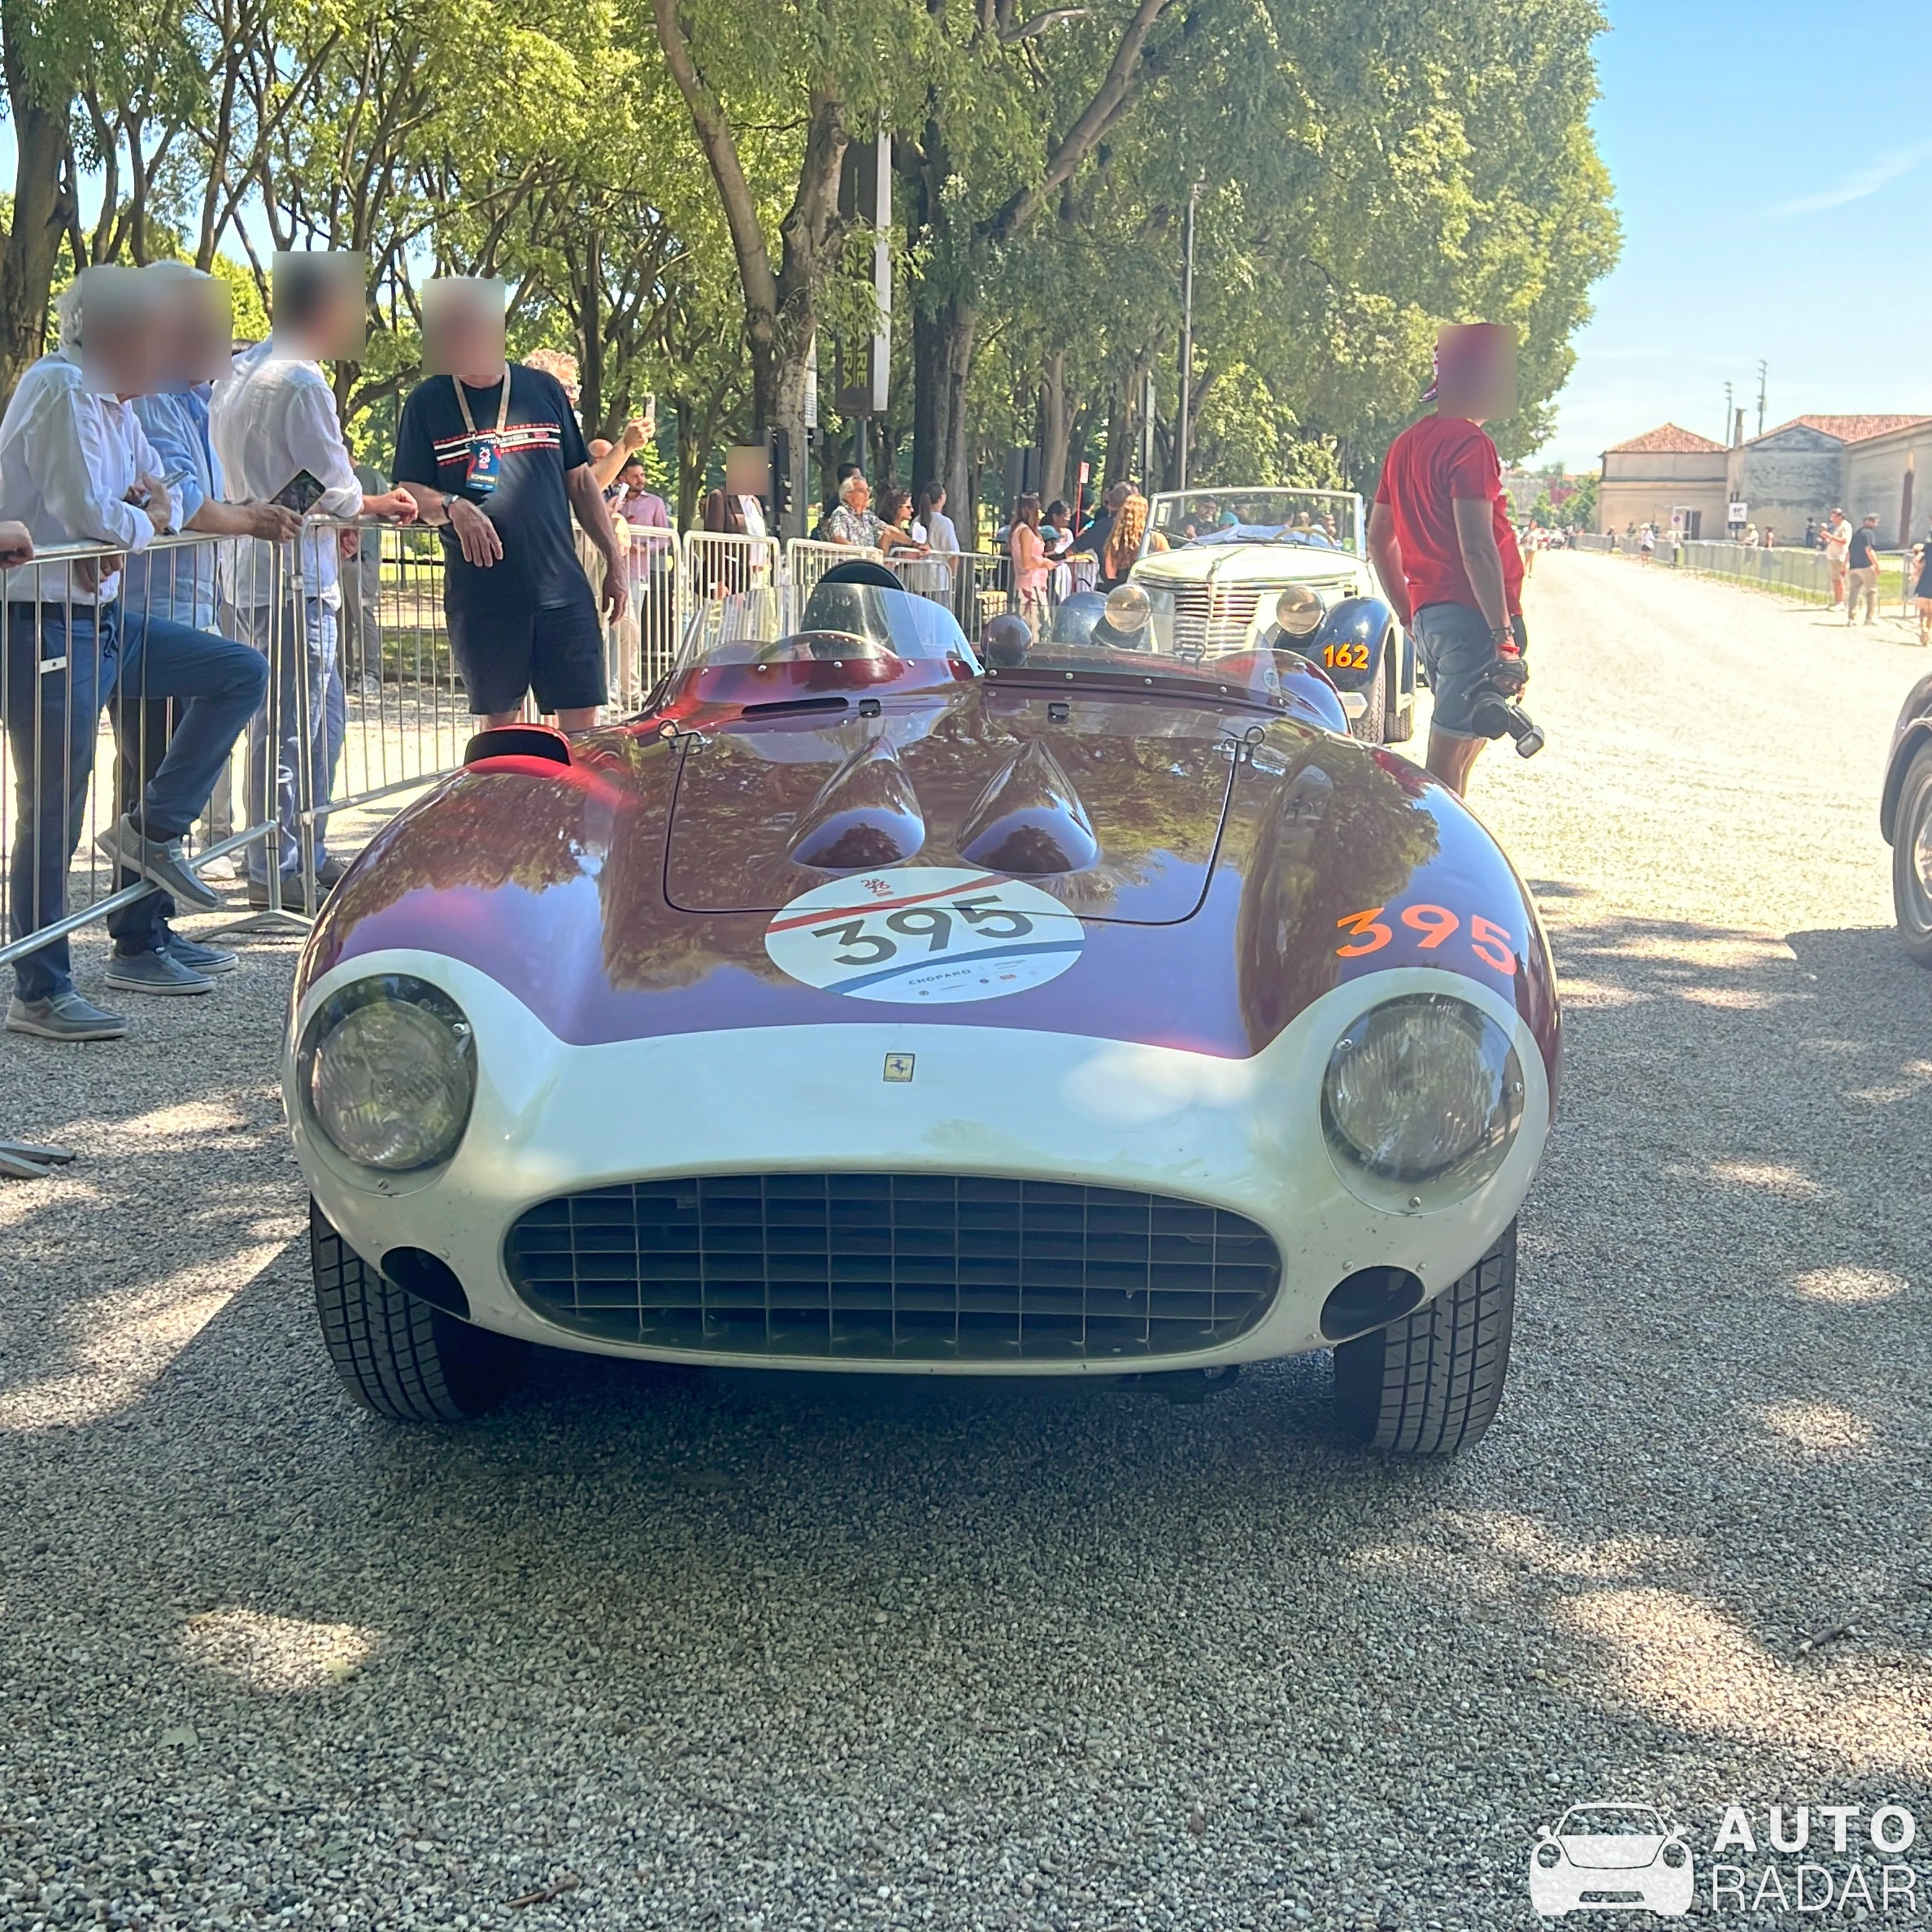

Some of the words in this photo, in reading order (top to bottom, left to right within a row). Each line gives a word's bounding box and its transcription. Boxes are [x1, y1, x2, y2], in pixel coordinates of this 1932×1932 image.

[1323, 643, 1369, 669] 162
[812, 895, 1033, 965] 395
[1336, 903, 1517, 976] 395
[908, 968, 971, 986] CHOPARD
